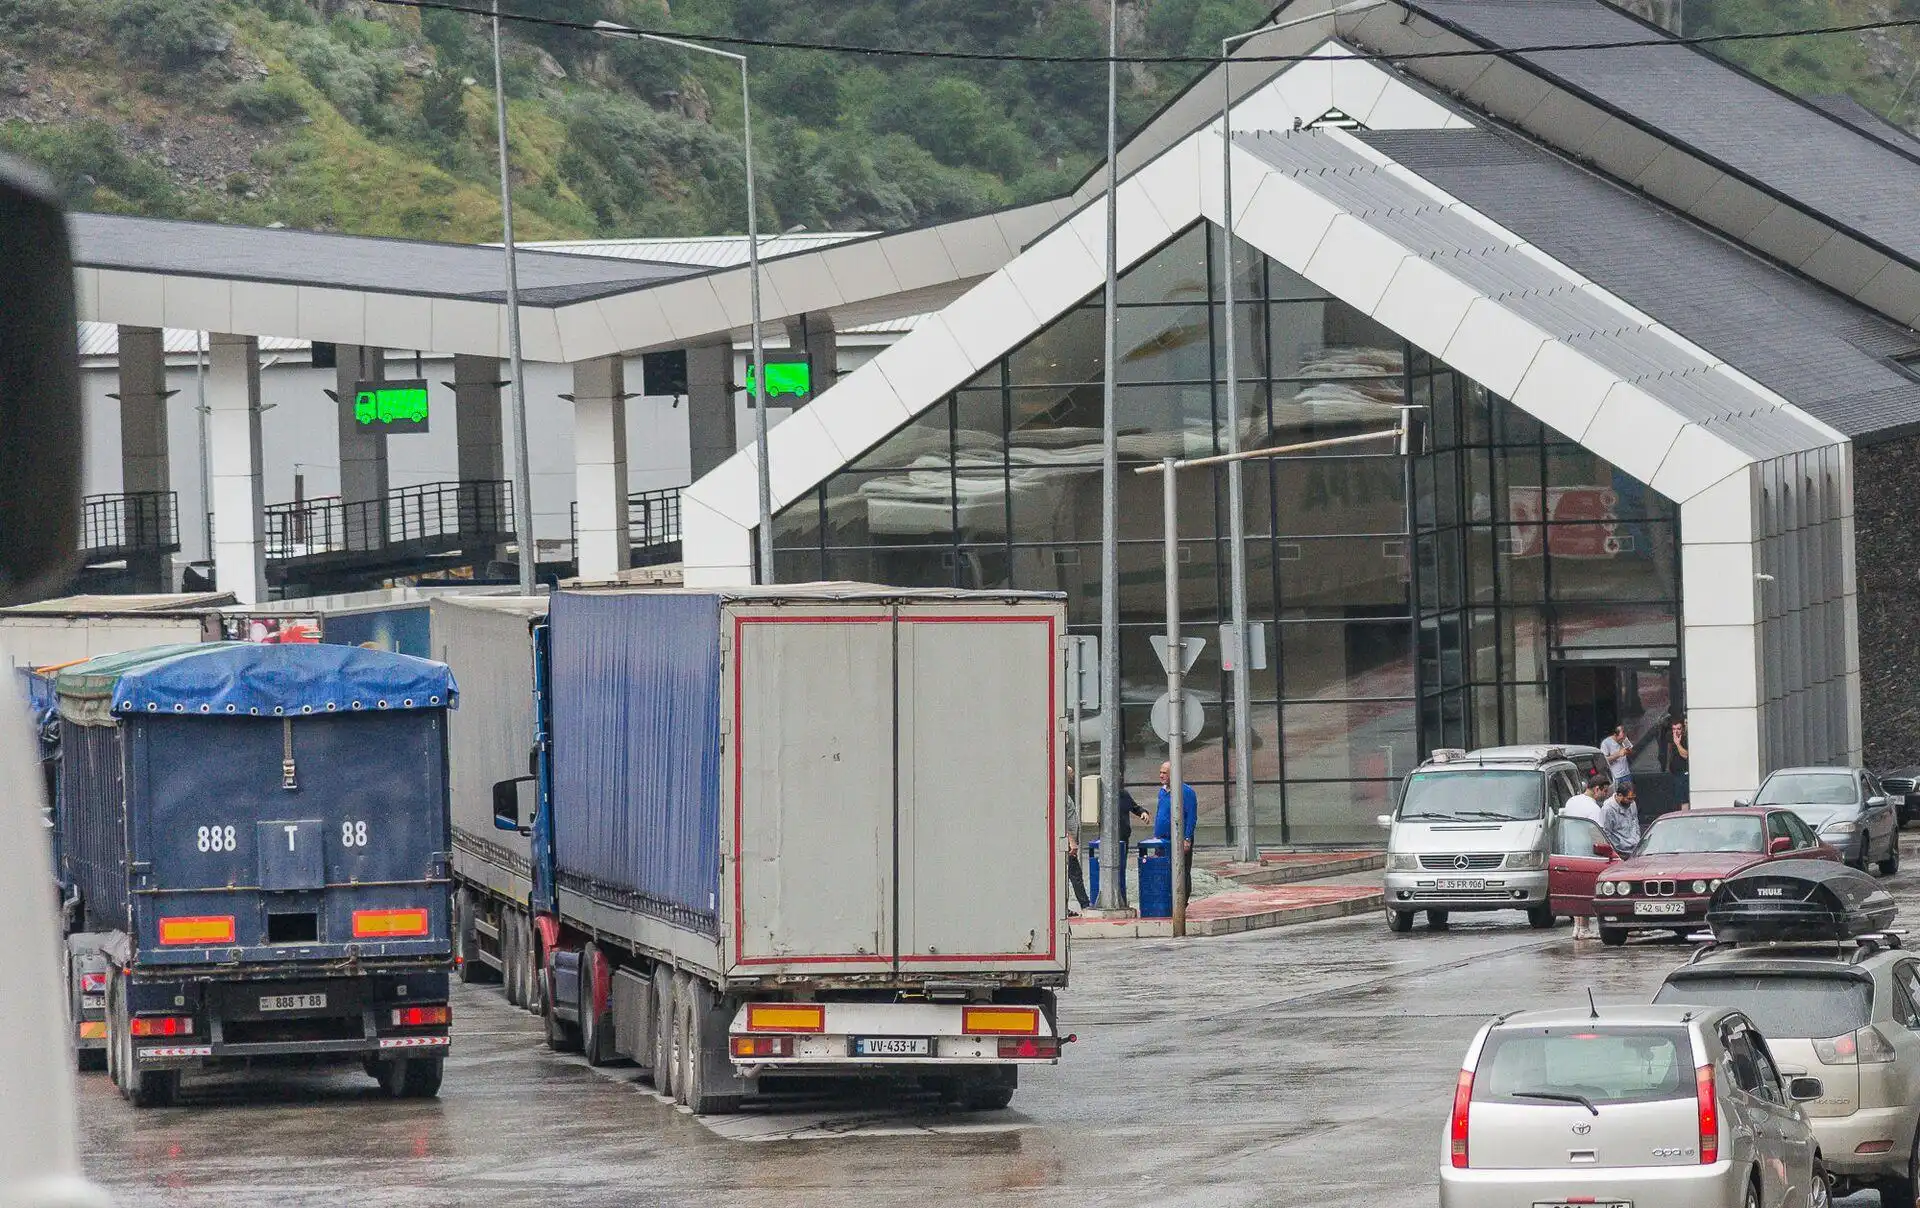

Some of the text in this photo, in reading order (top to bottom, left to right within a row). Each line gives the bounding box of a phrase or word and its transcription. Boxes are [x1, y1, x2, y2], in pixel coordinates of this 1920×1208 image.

[197, 821, 367, 852] 888 T 88
[1447, 880, 1455, 888] 35
[1457, 880, 1467, 888] FR
[1757, 888, 1782, 896] THULE
[276, 997, 294, 1008] 888
[298, 997, 304, 1007] T
[309, 995, 321, 1006] 88
[870, 1040, 917, 1052] VV-433-W
